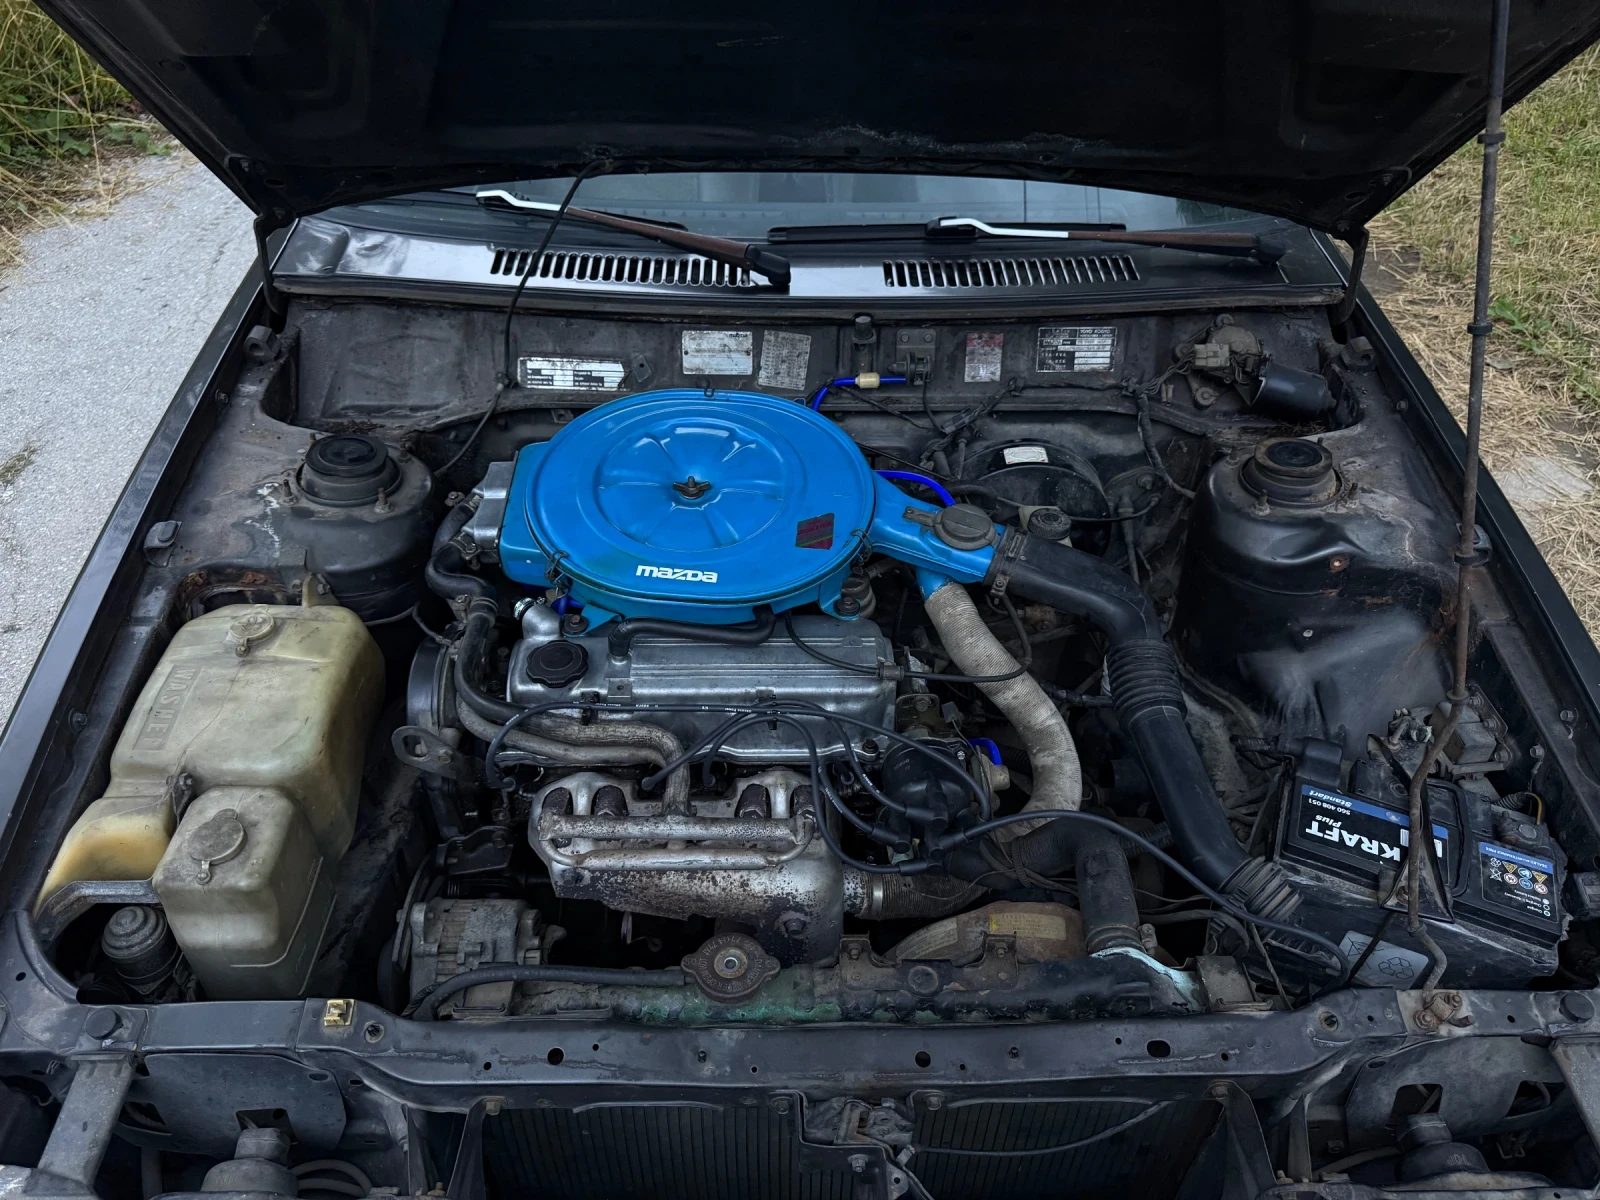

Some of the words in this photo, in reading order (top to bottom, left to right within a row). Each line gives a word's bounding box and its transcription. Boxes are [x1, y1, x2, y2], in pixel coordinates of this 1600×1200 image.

[1309, 789, 1353, 808] Standart
[1314, 814, 1342, 828] Plus
[1305, 820, 1401, 862] KRAFT
